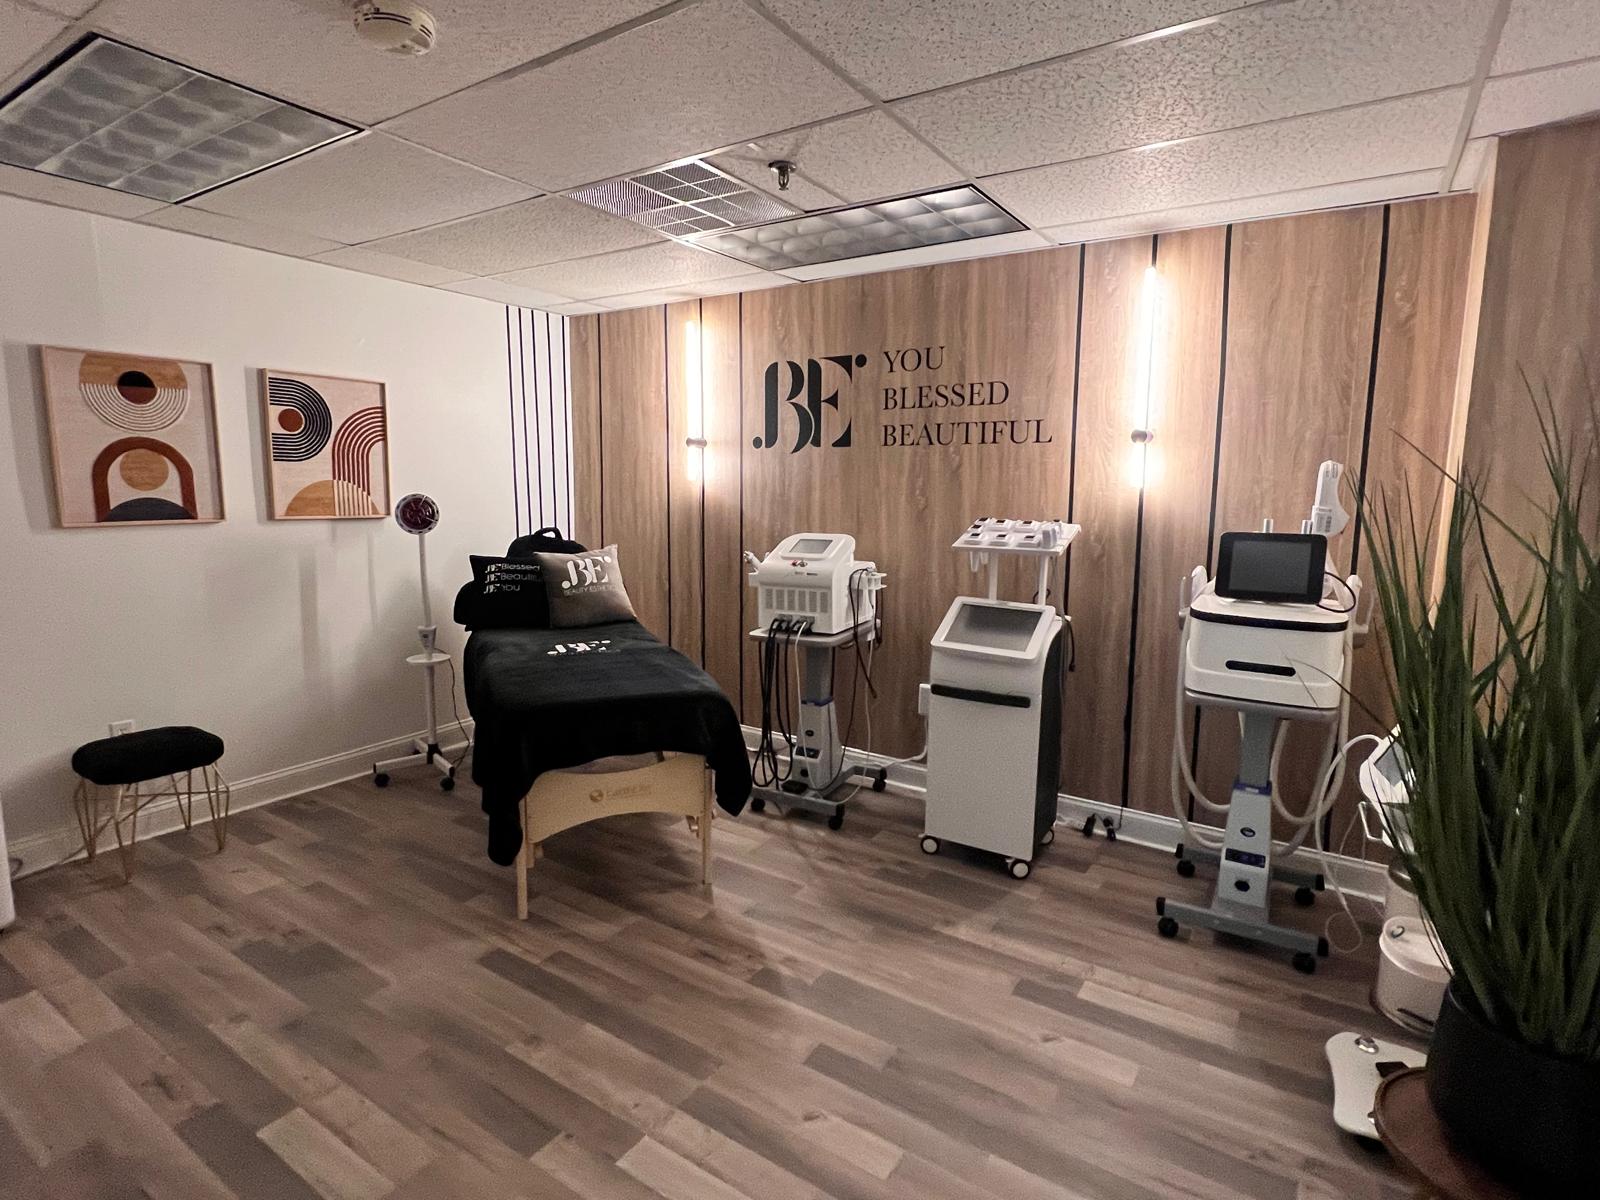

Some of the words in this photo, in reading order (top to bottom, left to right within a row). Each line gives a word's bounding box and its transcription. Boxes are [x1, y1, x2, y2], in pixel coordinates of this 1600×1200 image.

[883, 346, 946, 373] YOU
[883, 380, 1010, 410] BLESSED
[882, 418, 1053, 447] BEAUTIFUL
